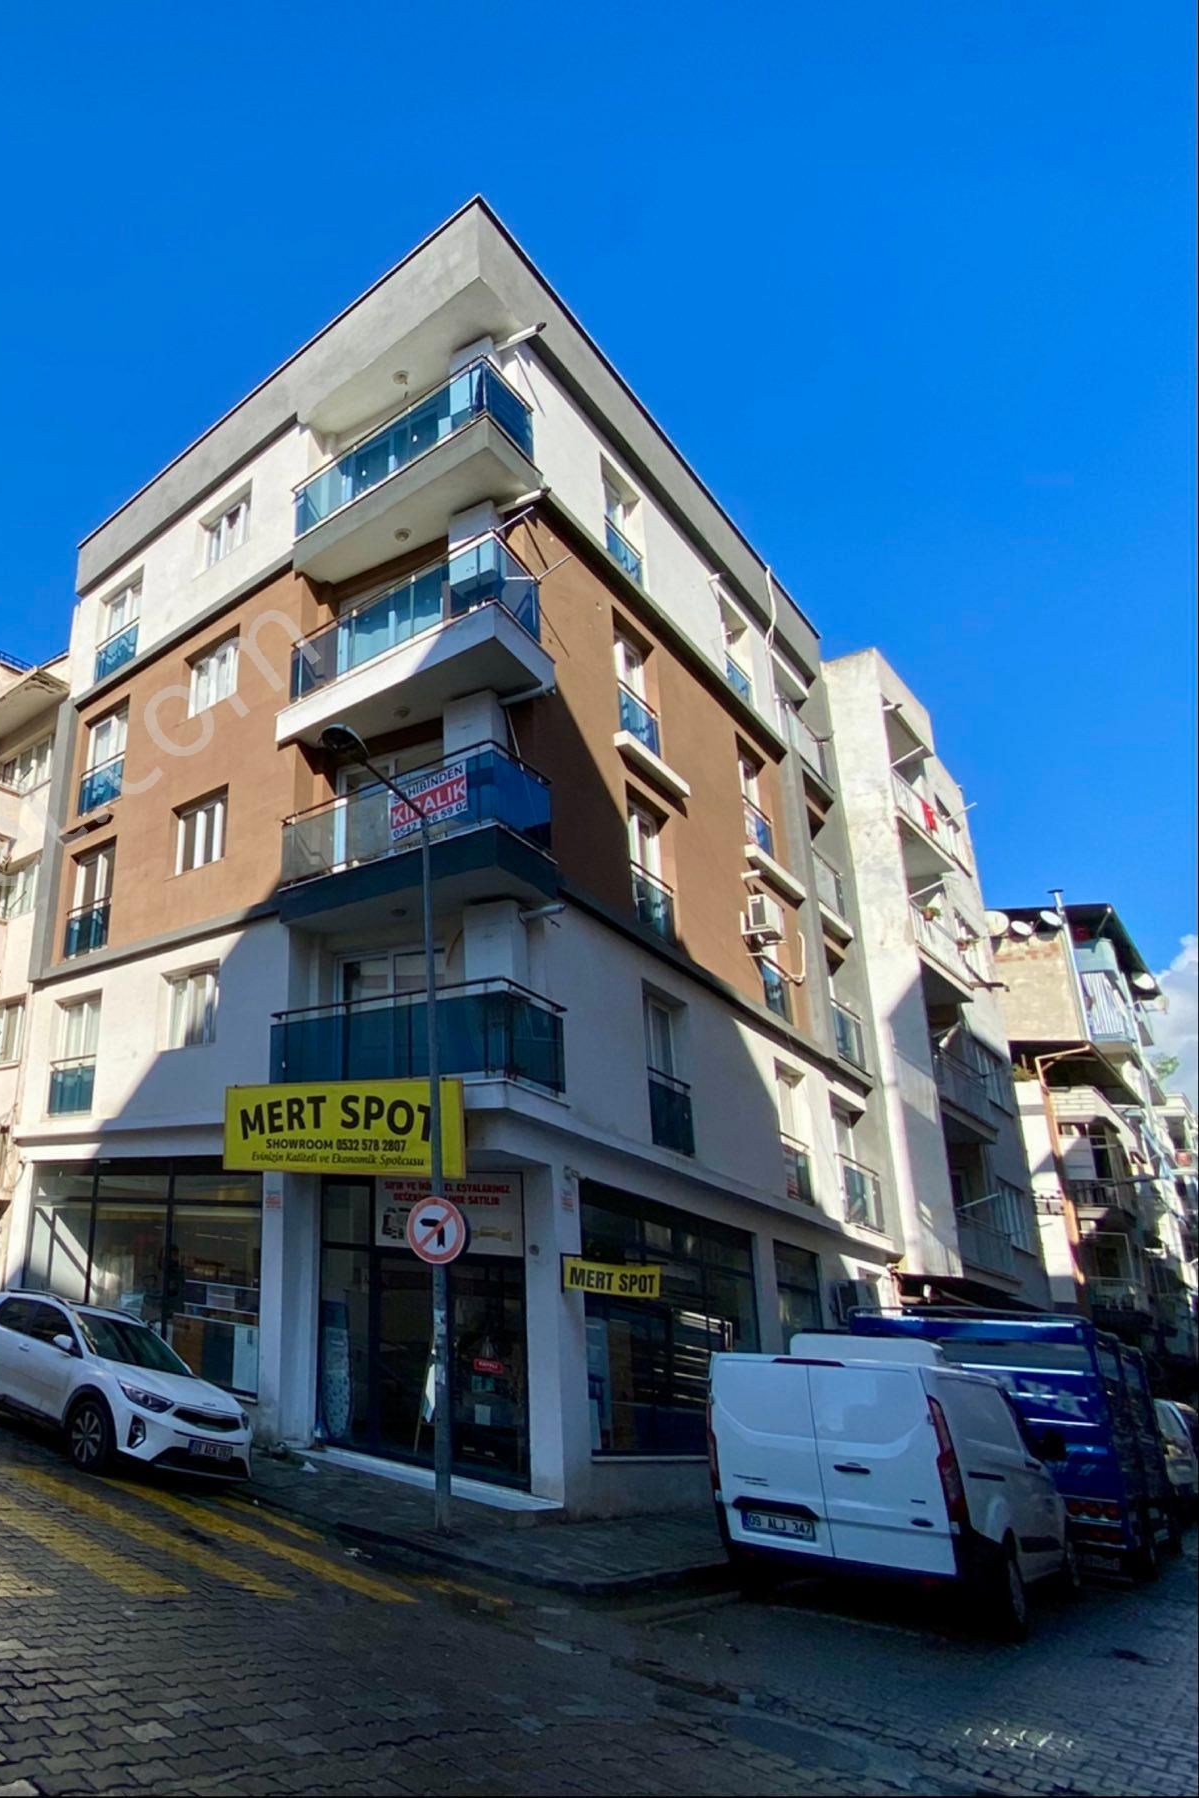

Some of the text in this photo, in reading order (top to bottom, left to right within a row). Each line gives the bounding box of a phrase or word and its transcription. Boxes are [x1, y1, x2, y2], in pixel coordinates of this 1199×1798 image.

[240, 1095, 430, 1142] MERT SPOT
[266, 1139, 333, 1149] SHOWROOM
[337, 1138, 359, 1150] 0532
[332, 1153, 376, 1164] Ekonomik
[570, 1267, 655, 1293] MERT SPOT
